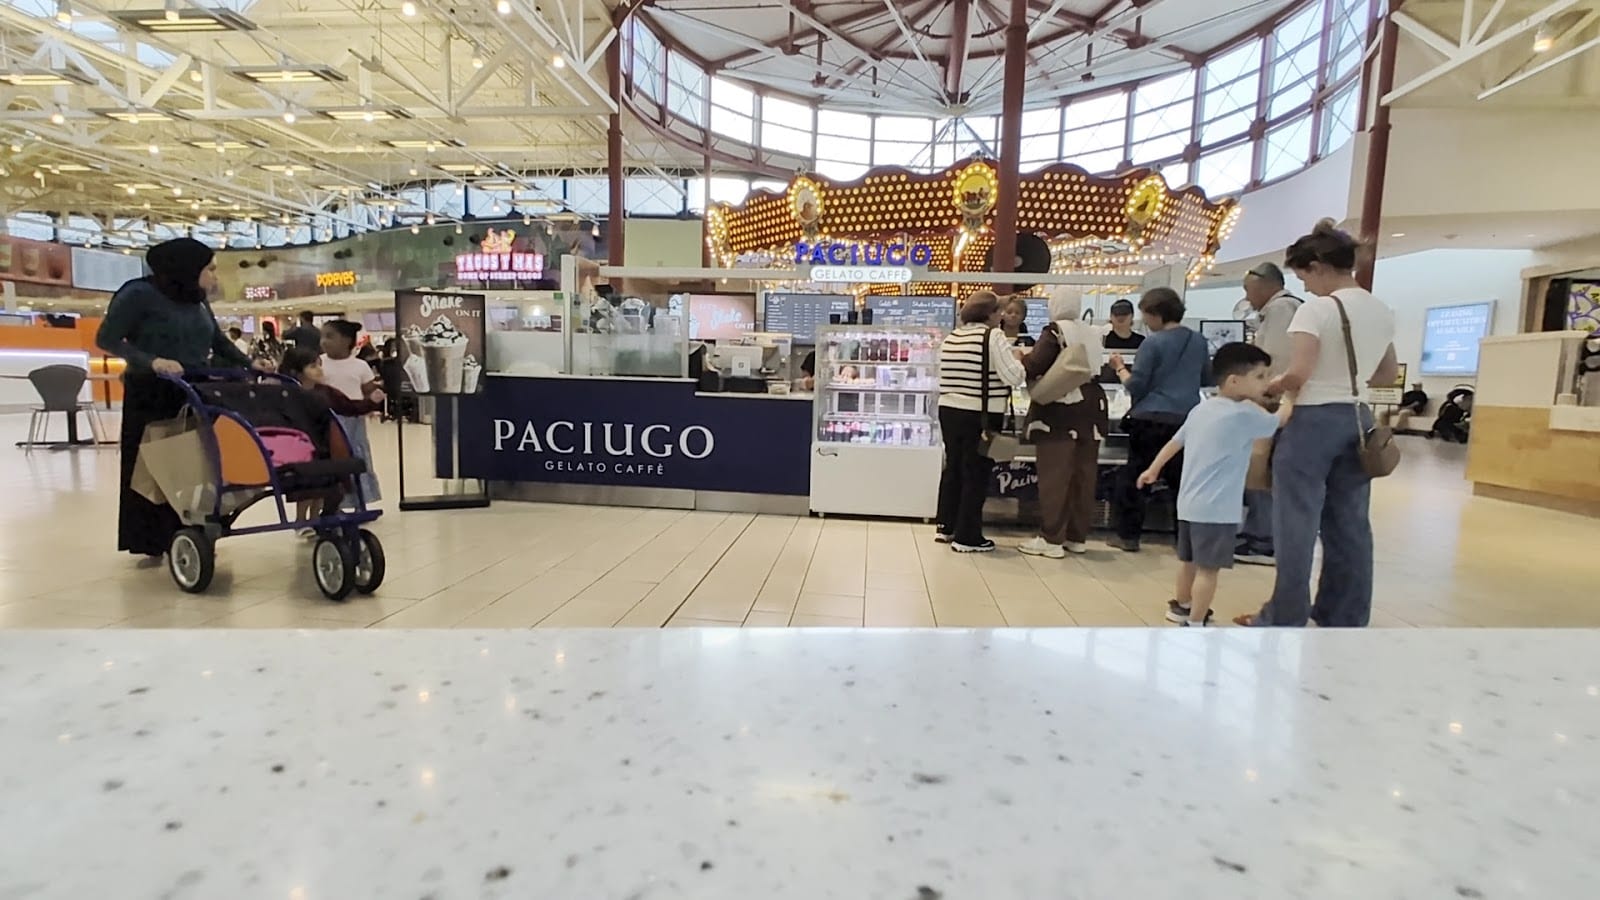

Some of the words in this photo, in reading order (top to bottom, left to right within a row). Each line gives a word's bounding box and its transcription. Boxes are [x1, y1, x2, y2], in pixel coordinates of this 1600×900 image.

[456, 253, 499, 272] TACOS
[500, 253, 511, 271] Y
[512, 252, 544, 272] MAS
[795, 242, 931, 266] PACIUGO
[316, 270, 355, 287] POPEYES
[814, 269, 864, 280] GELATO
[420, 295, 464, 317] Shake
[493, 418, 714, 459] PACIUGO
[545, 460, 607, 473] GELATO
[614, 463, 664, 475] CAFFÈ
[996, 471, 1038, 494] Paciu
